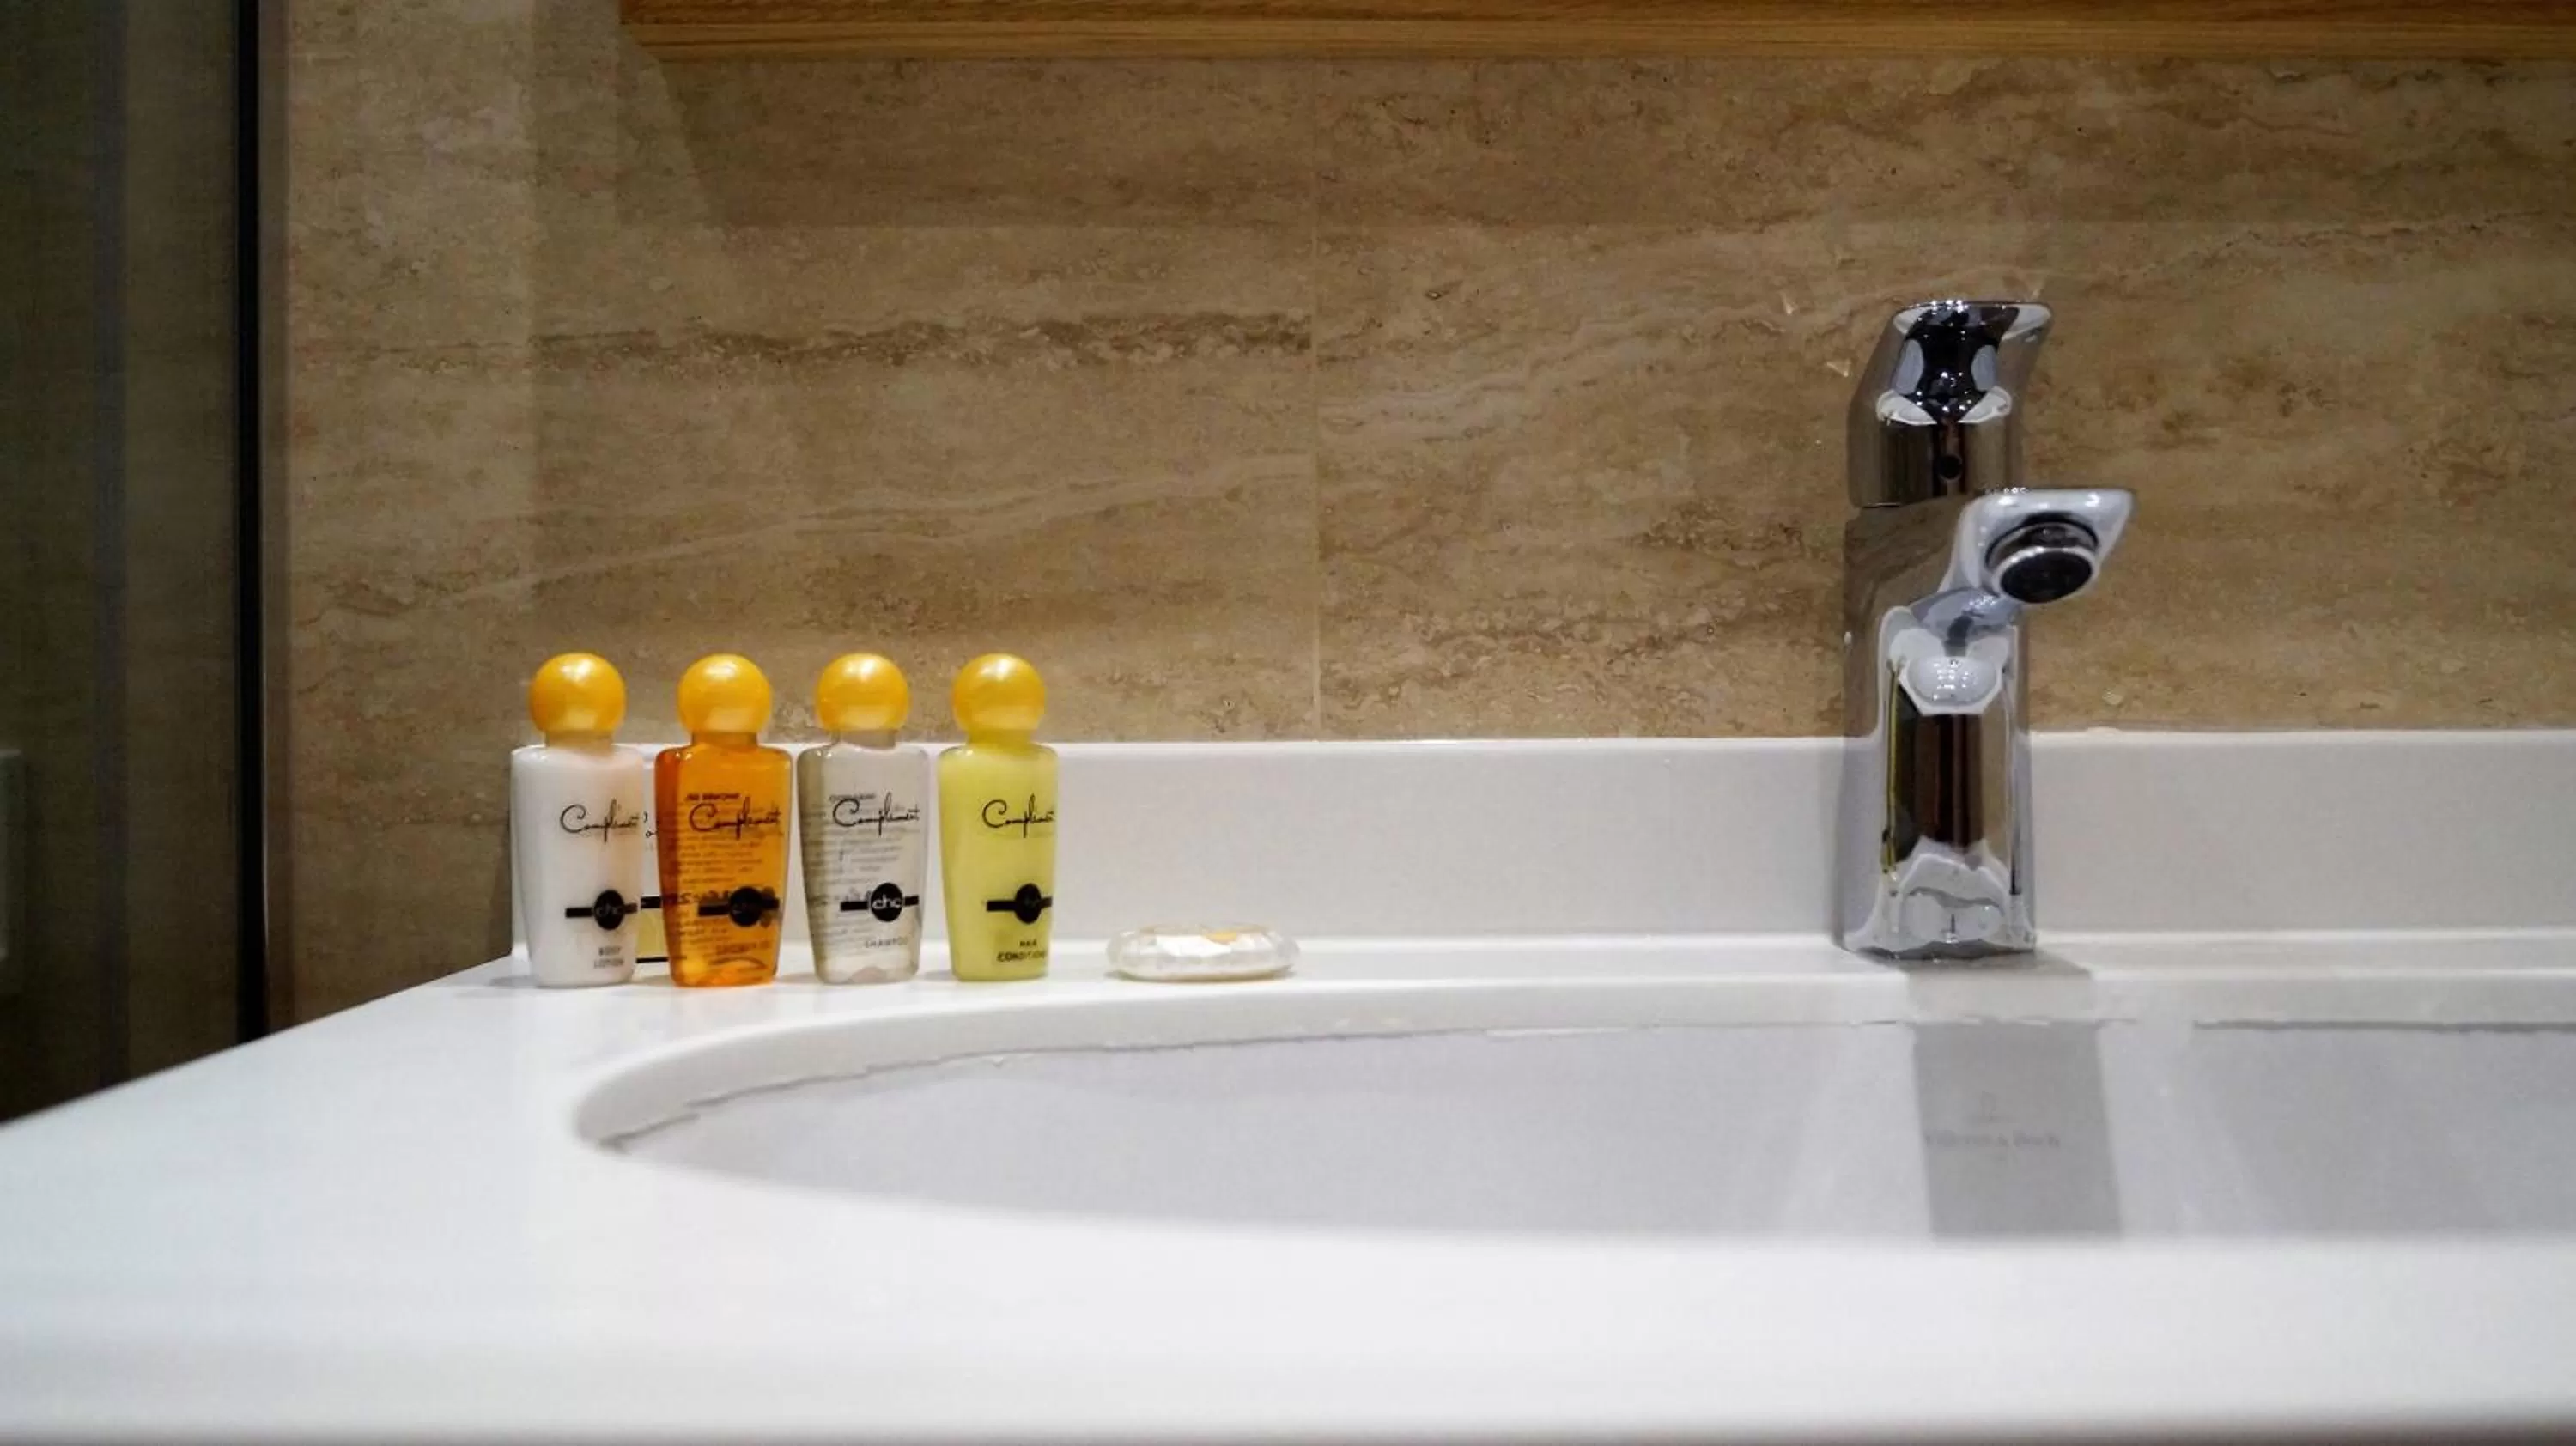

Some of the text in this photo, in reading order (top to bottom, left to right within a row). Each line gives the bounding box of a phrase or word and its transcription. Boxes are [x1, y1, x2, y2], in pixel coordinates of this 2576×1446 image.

[560, 799, 640, 843] Compliment
[689, 796, 781, 840] Compliment
[832, 792, 920, 837] Compliment
[981, 793, 1054, 839] Compliment
